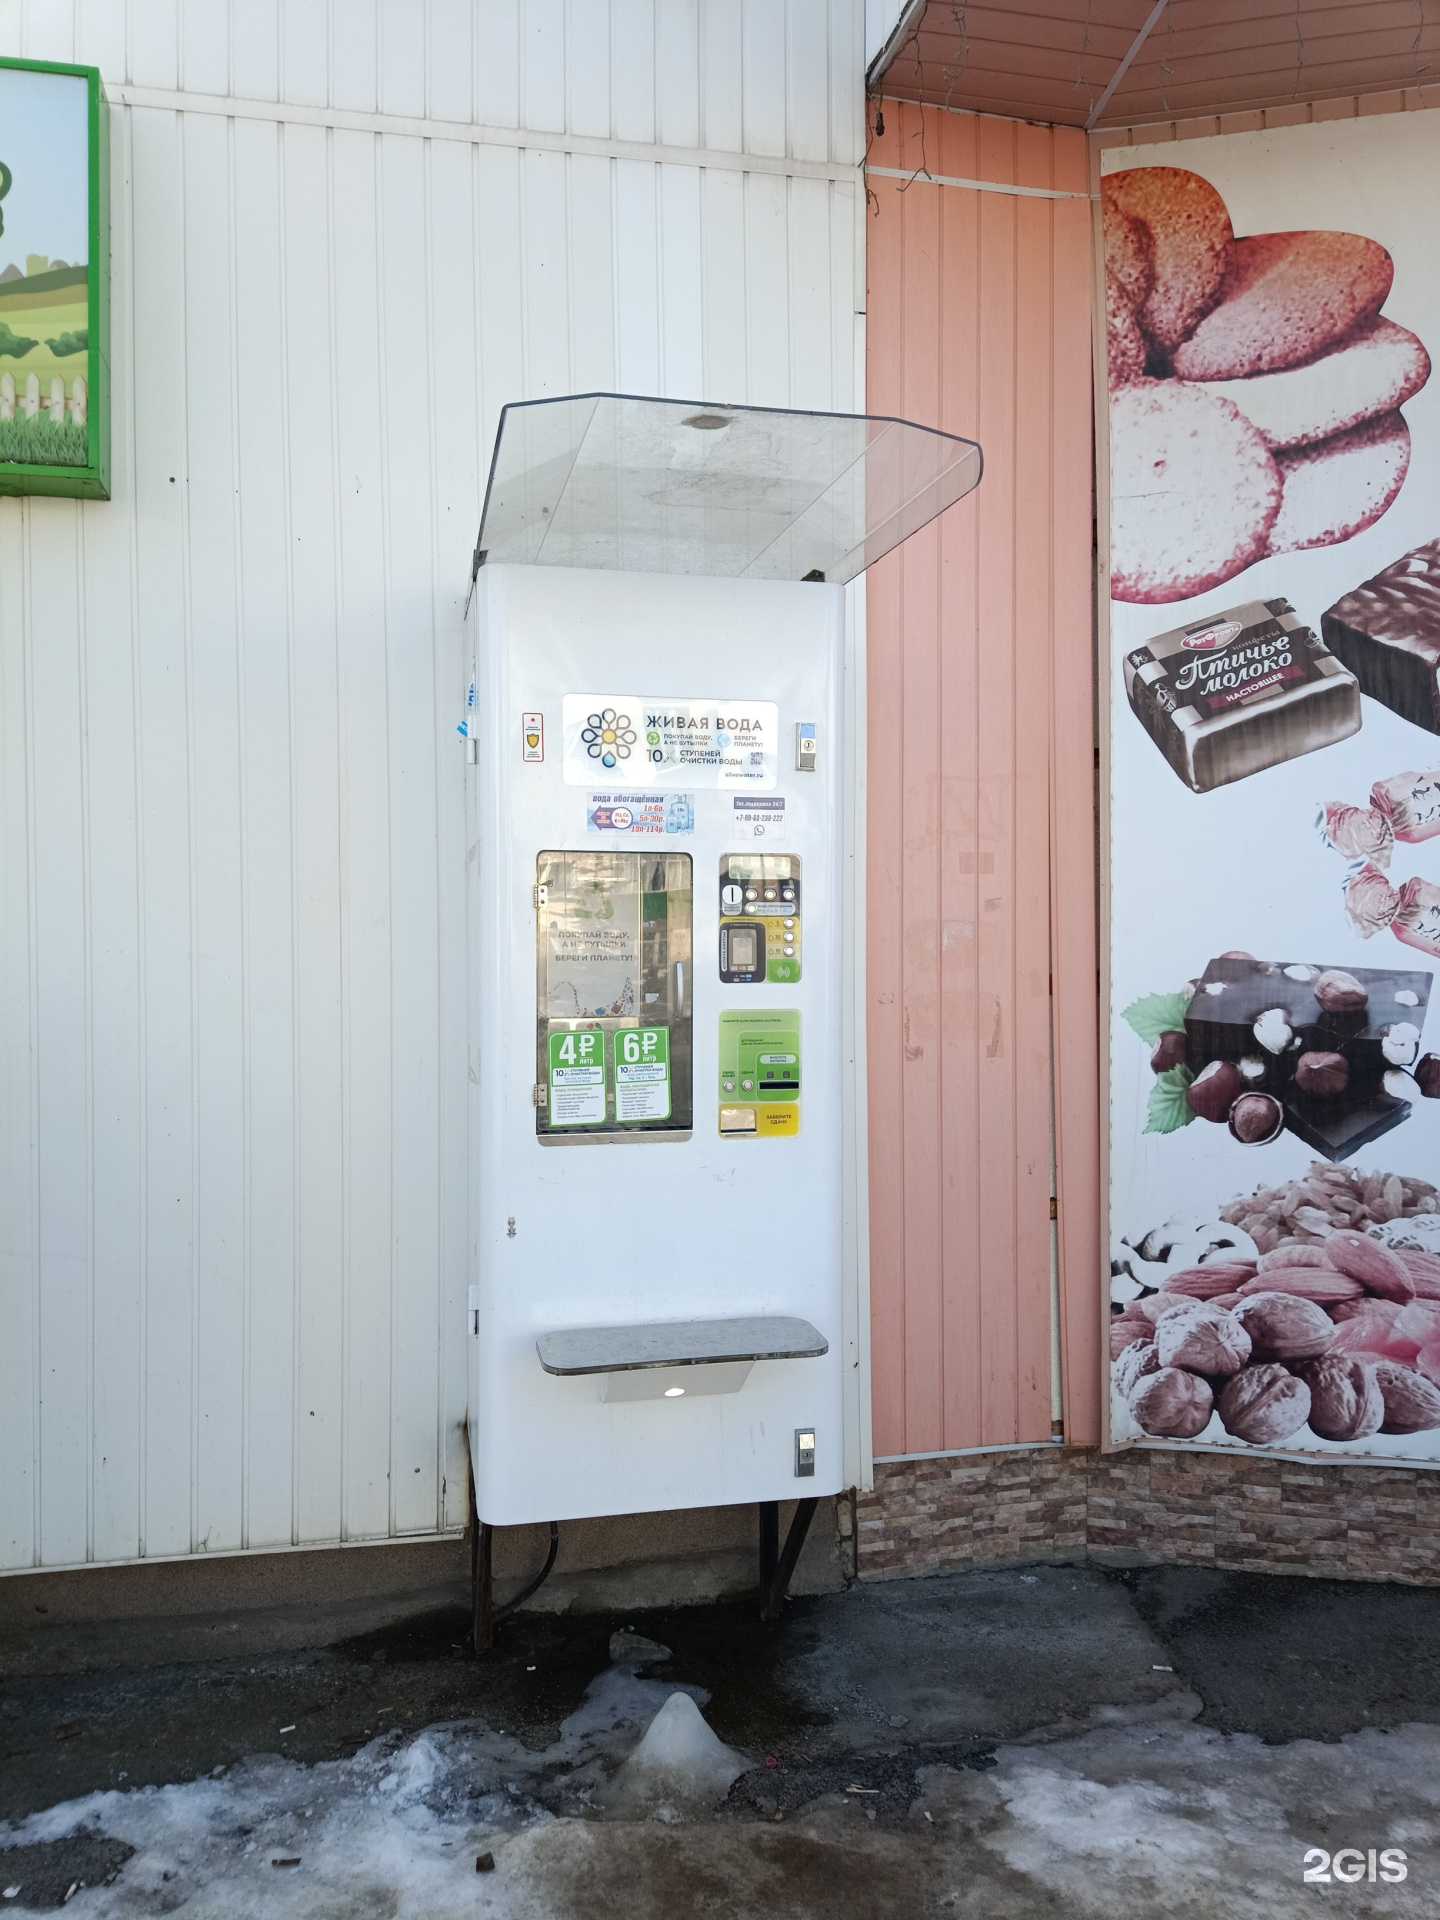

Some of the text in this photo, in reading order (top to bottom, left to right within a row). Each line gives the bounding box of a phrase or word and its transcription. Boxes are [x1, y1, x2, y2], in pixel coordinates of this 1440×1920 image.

[1175, 635, 1291, 690] Птичье
[1199, 652, 1293, 696] молоко
[646, 715, 763, 733] ЖИВАЯ ВОДА
[680, 749, 721, 757] СТУПЕНЕЙ
[558, 929, 602, 939] ПОКУПАЙ
[555, 954, 633, 962] БЕРЕГИ ПЛАНЕТУ!
